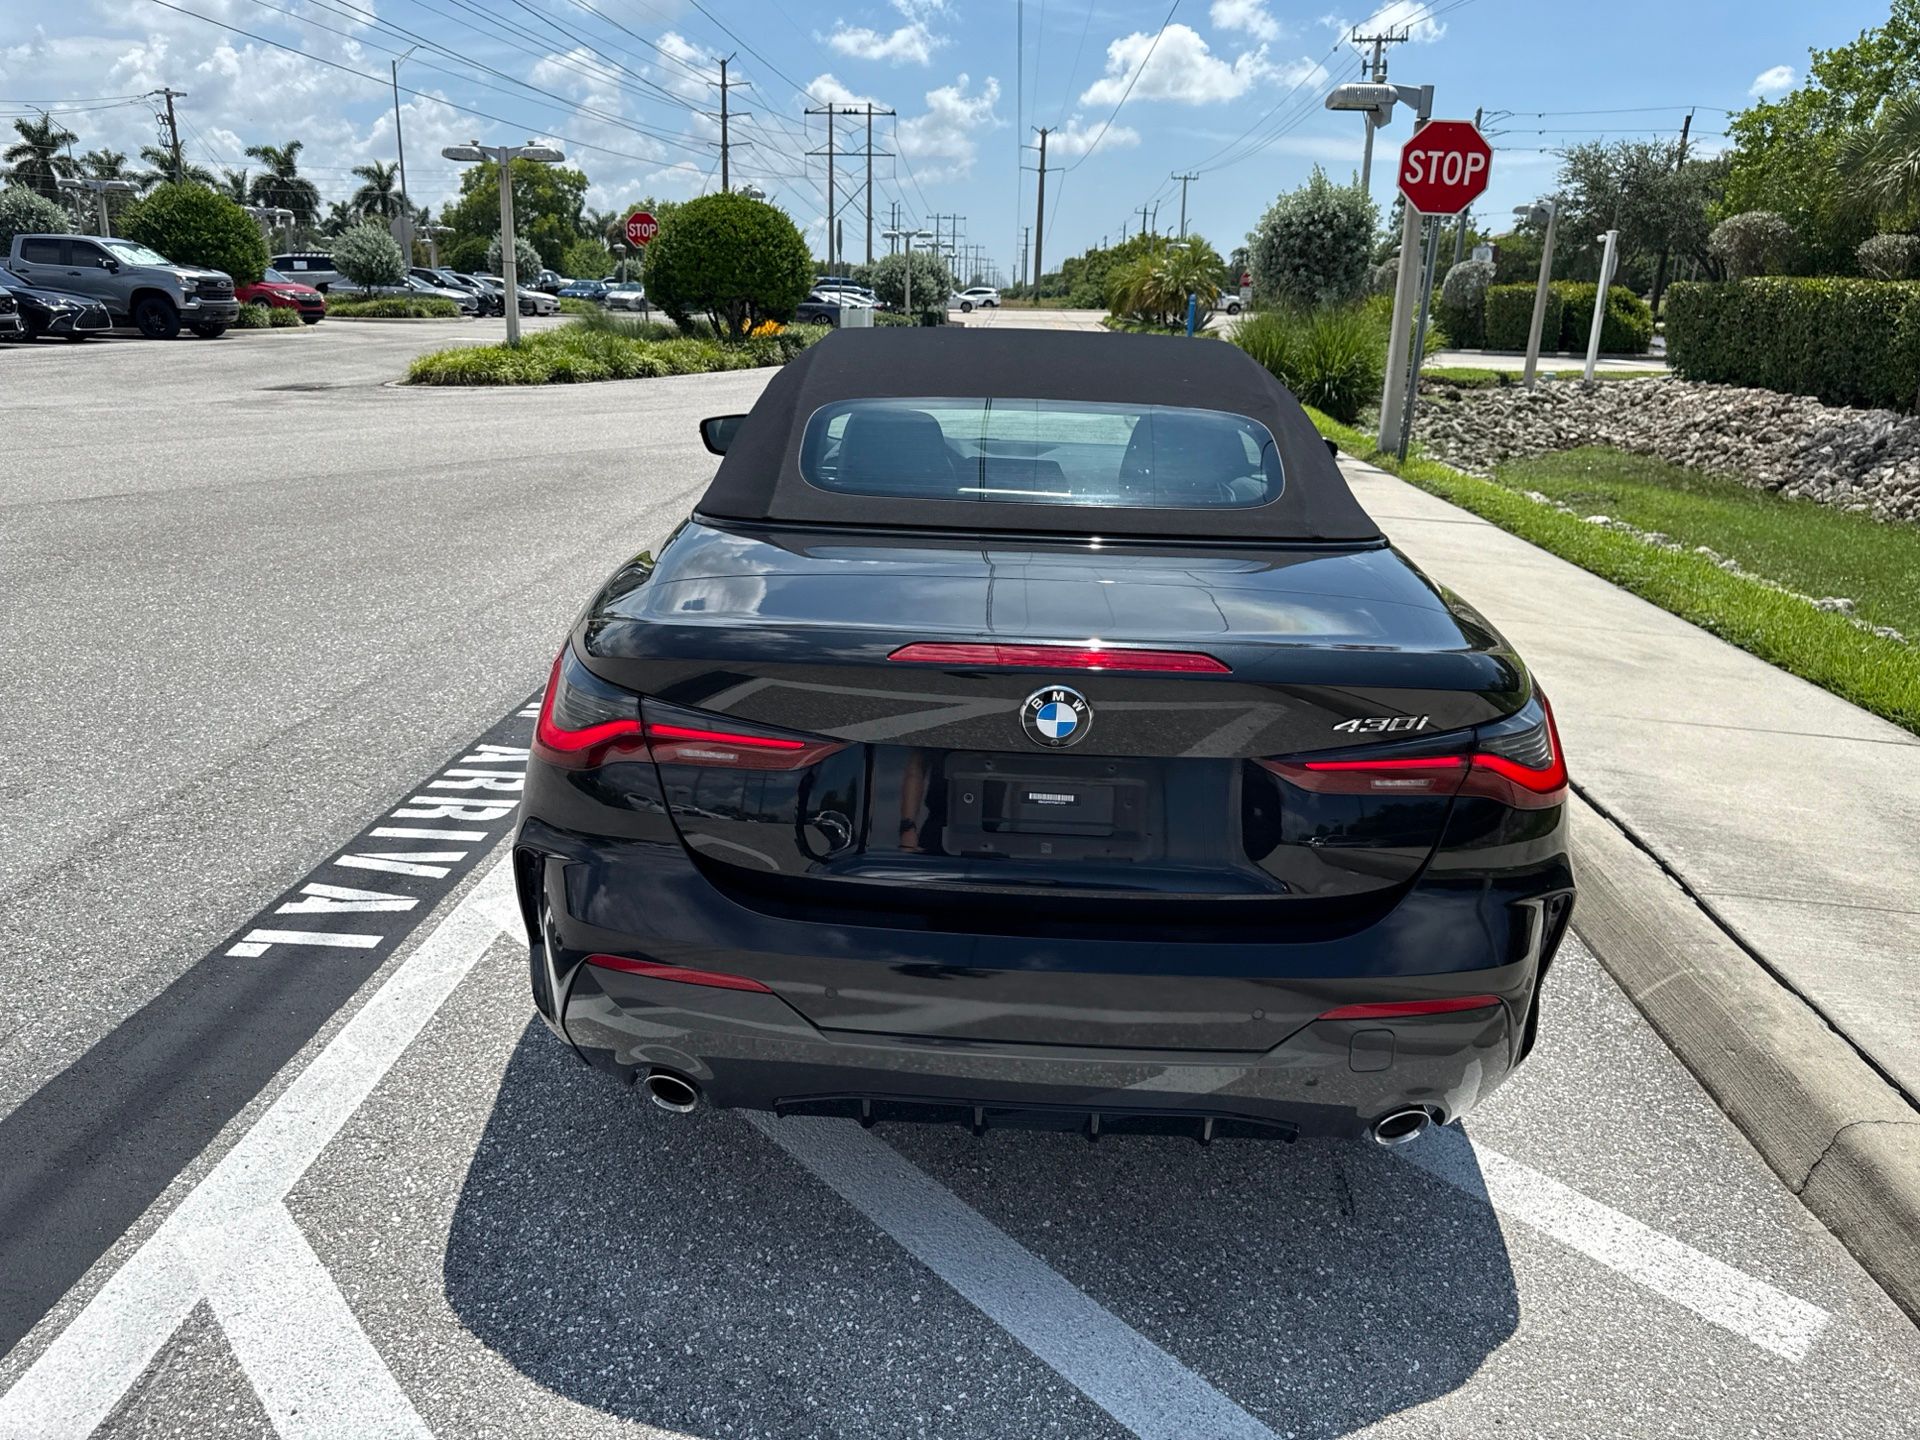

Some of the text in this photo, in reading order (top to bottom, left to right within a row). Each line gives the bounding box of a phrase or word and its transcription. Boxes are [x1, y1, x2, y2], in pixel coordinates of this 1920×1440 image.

[1405, 150, 1485, 186] STOP
[629, 223, 657, 238] STOP
[1031, 691, 1086, 712] BMW
[1333, 716, 1429, 733] 430i
[225, 744, 531, 957] ARRIVAL
